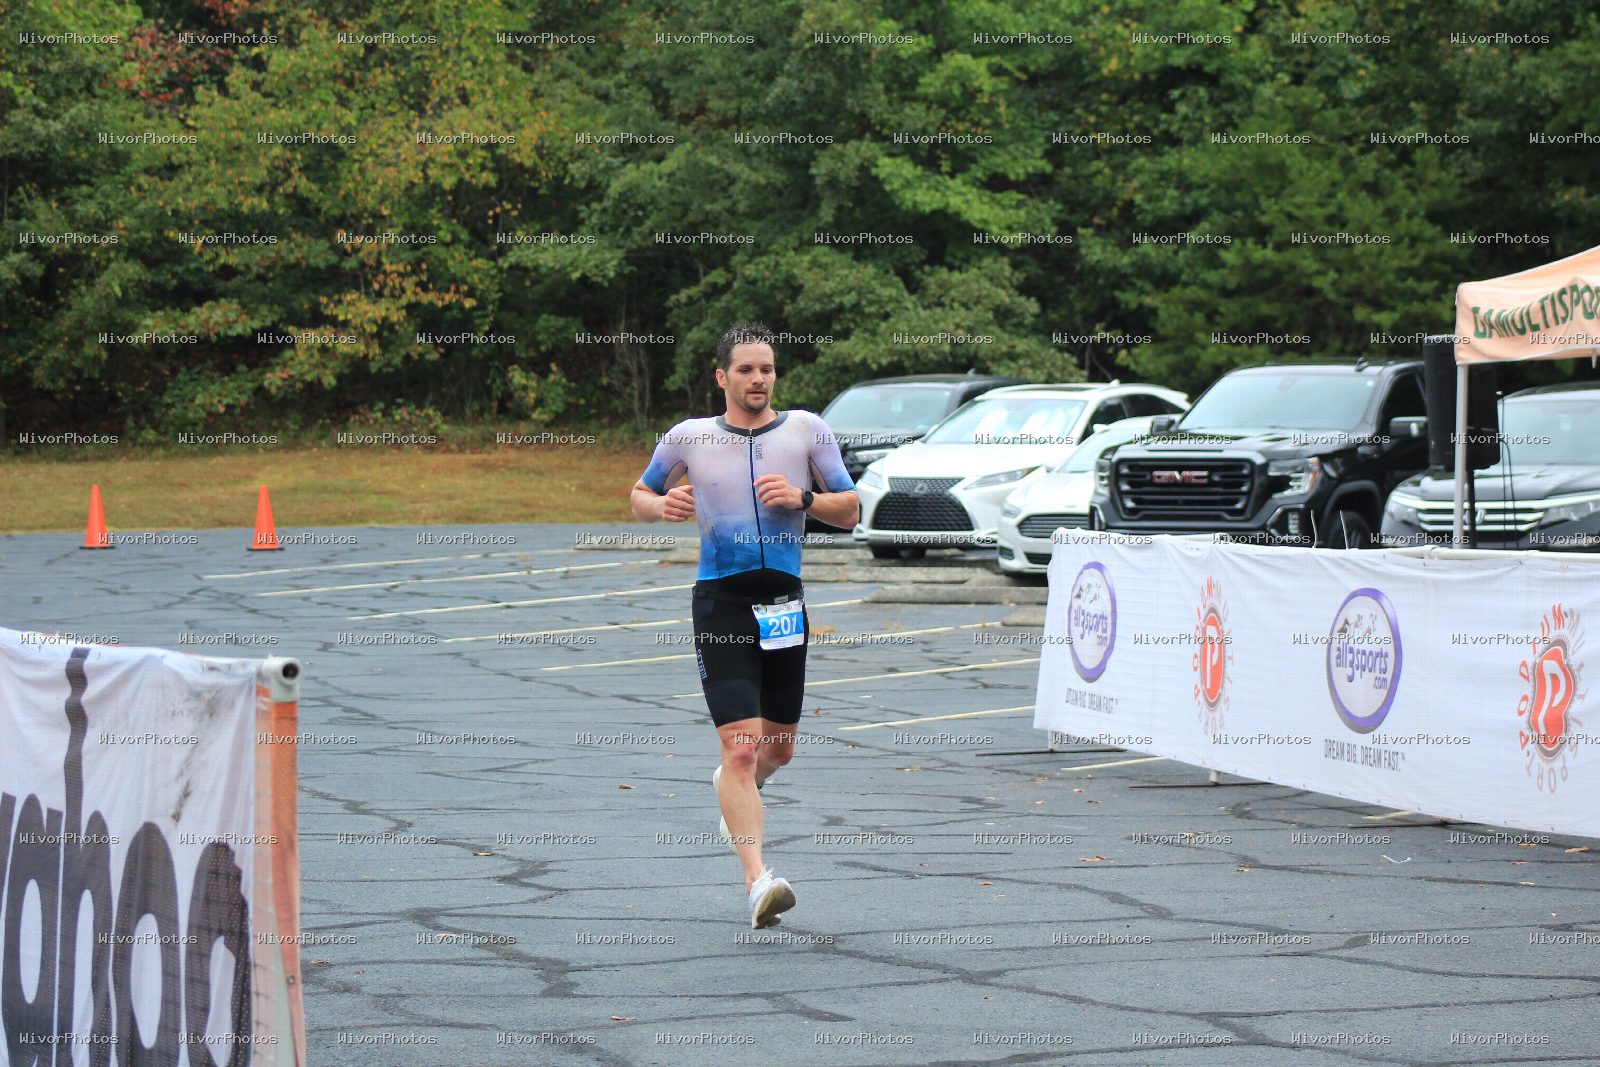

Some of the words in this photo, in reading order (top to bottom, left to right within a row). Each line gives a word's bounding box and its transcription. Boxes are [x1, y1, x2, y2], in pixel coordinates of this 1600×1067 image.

[1152, 470, 1209, 484] GMC
[768, 614, 797, 637] 201
[1335, 641, 1389, 683] all3sports
[1373, 675, 1388, 690] .com
[1324, 738, 1345, 761] DREAM
[1360, 745, 1382, 769] DREAM
[0, 647, 253, 1067] ahoo
